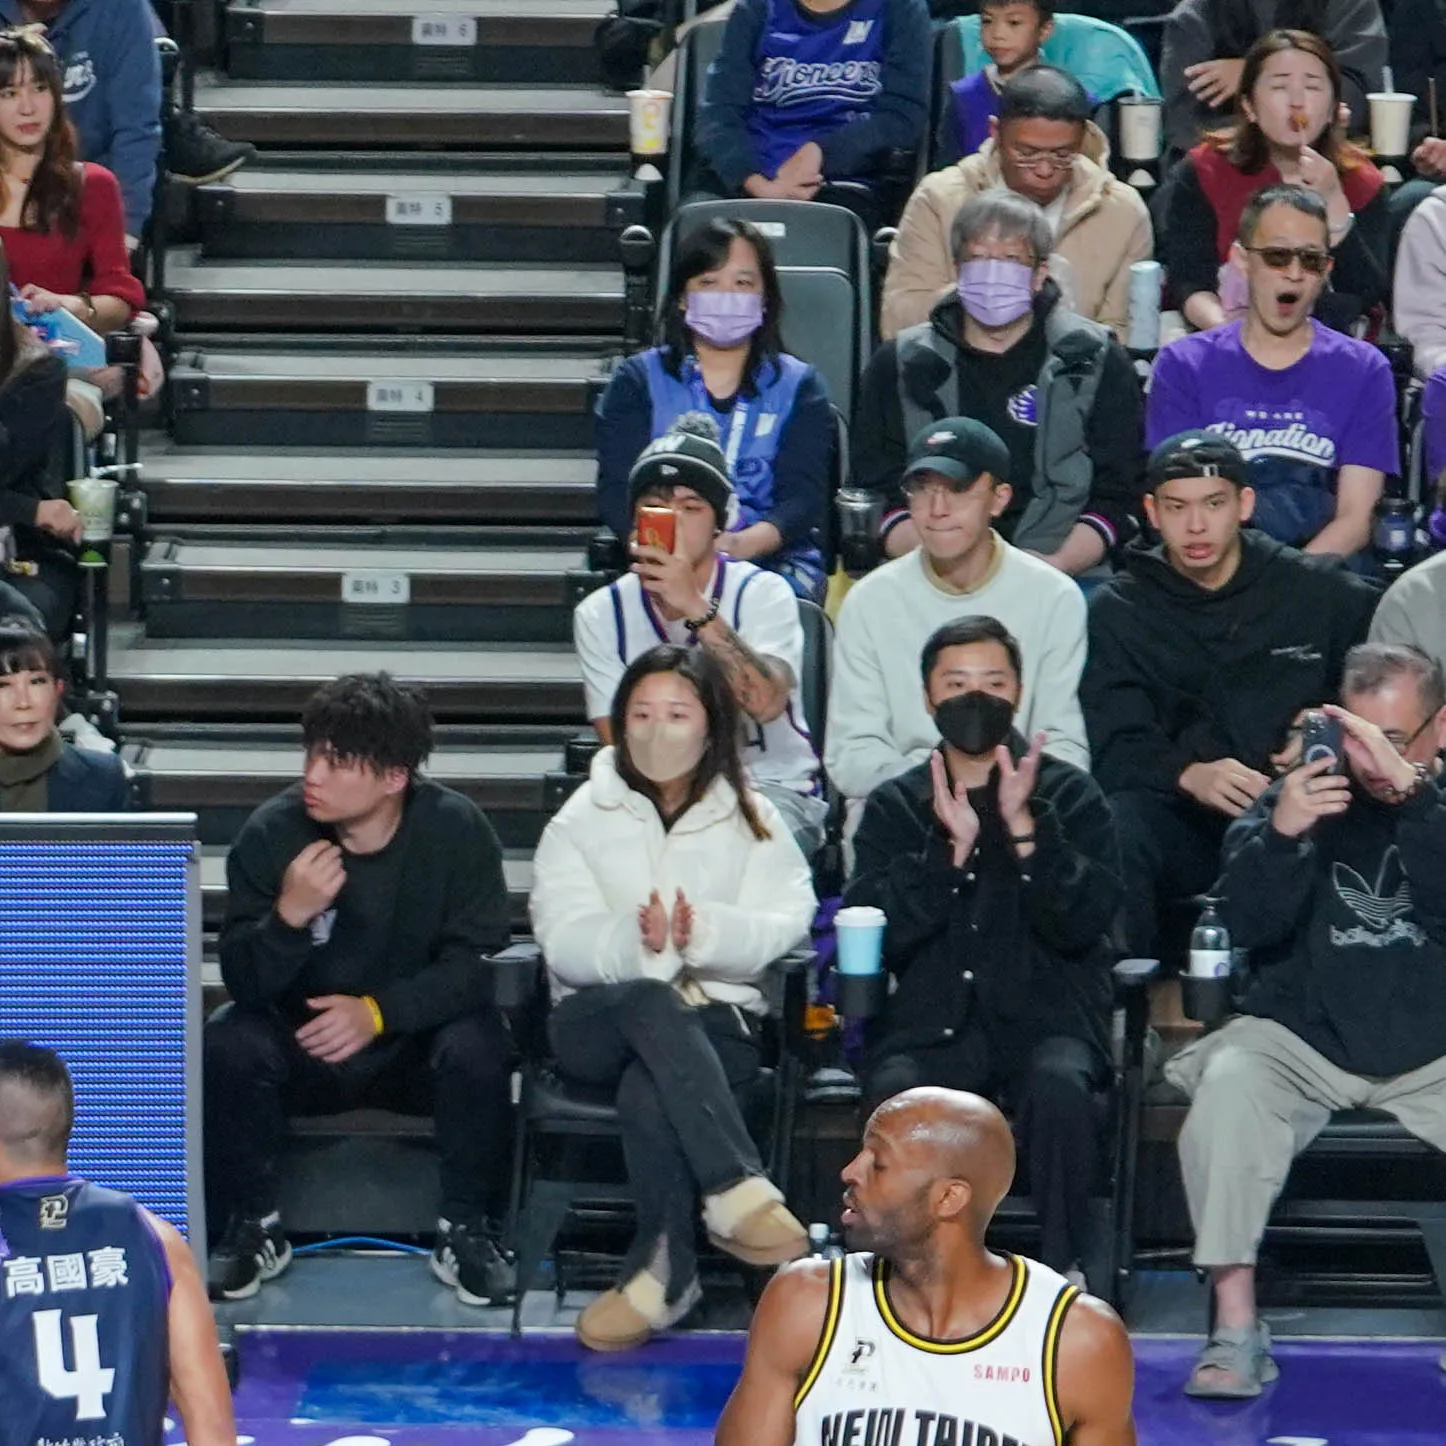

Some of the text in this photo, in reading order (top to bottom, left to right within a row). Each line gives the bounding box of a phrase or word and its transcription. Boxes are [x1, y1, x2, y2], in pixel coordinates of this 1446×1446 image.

[3, 1245, 129, 1298] 高國豪
[32, 1309, 116, 1420] 4
[973, 1363, 1031, 1383] SAMPO
